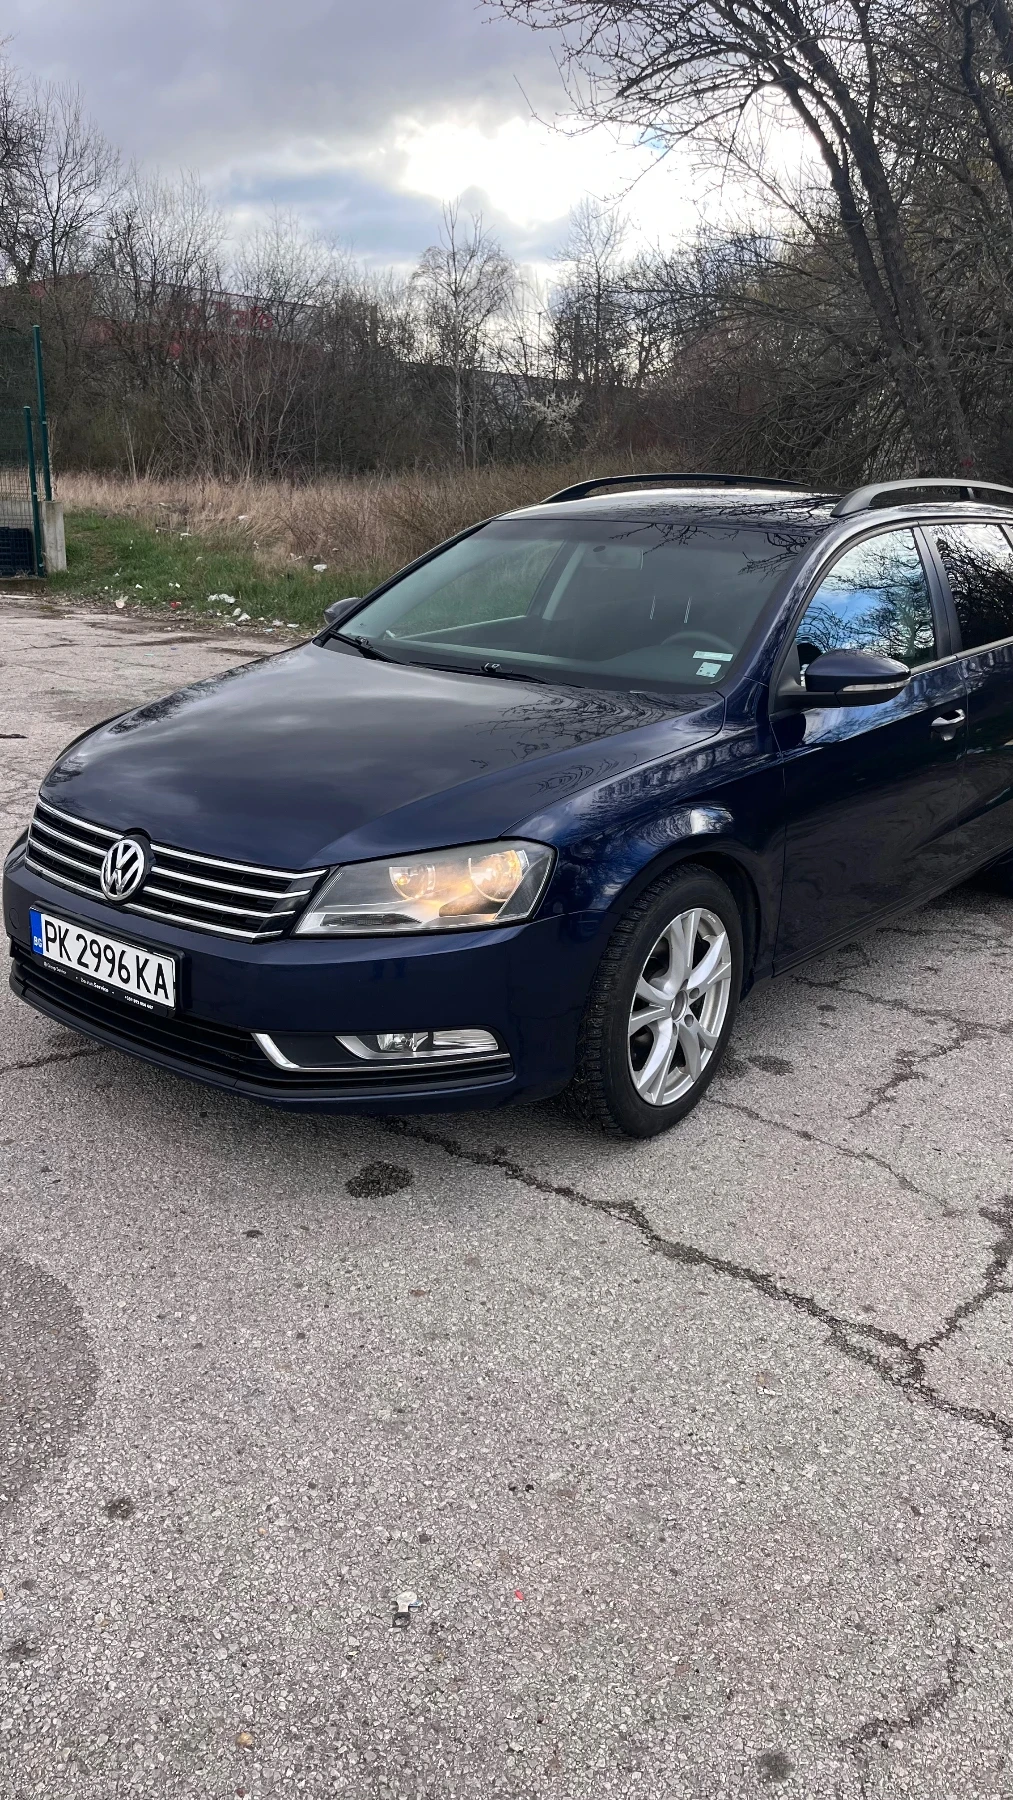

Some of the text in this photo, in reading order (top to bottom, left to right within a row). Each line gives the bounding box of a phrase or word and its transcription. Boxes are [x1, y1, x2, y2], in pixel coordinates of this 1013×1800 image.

[100, 839, 144, 901] VW
[33, 936, 43, 948] BG
[75, 933, 131, 985] 2996
